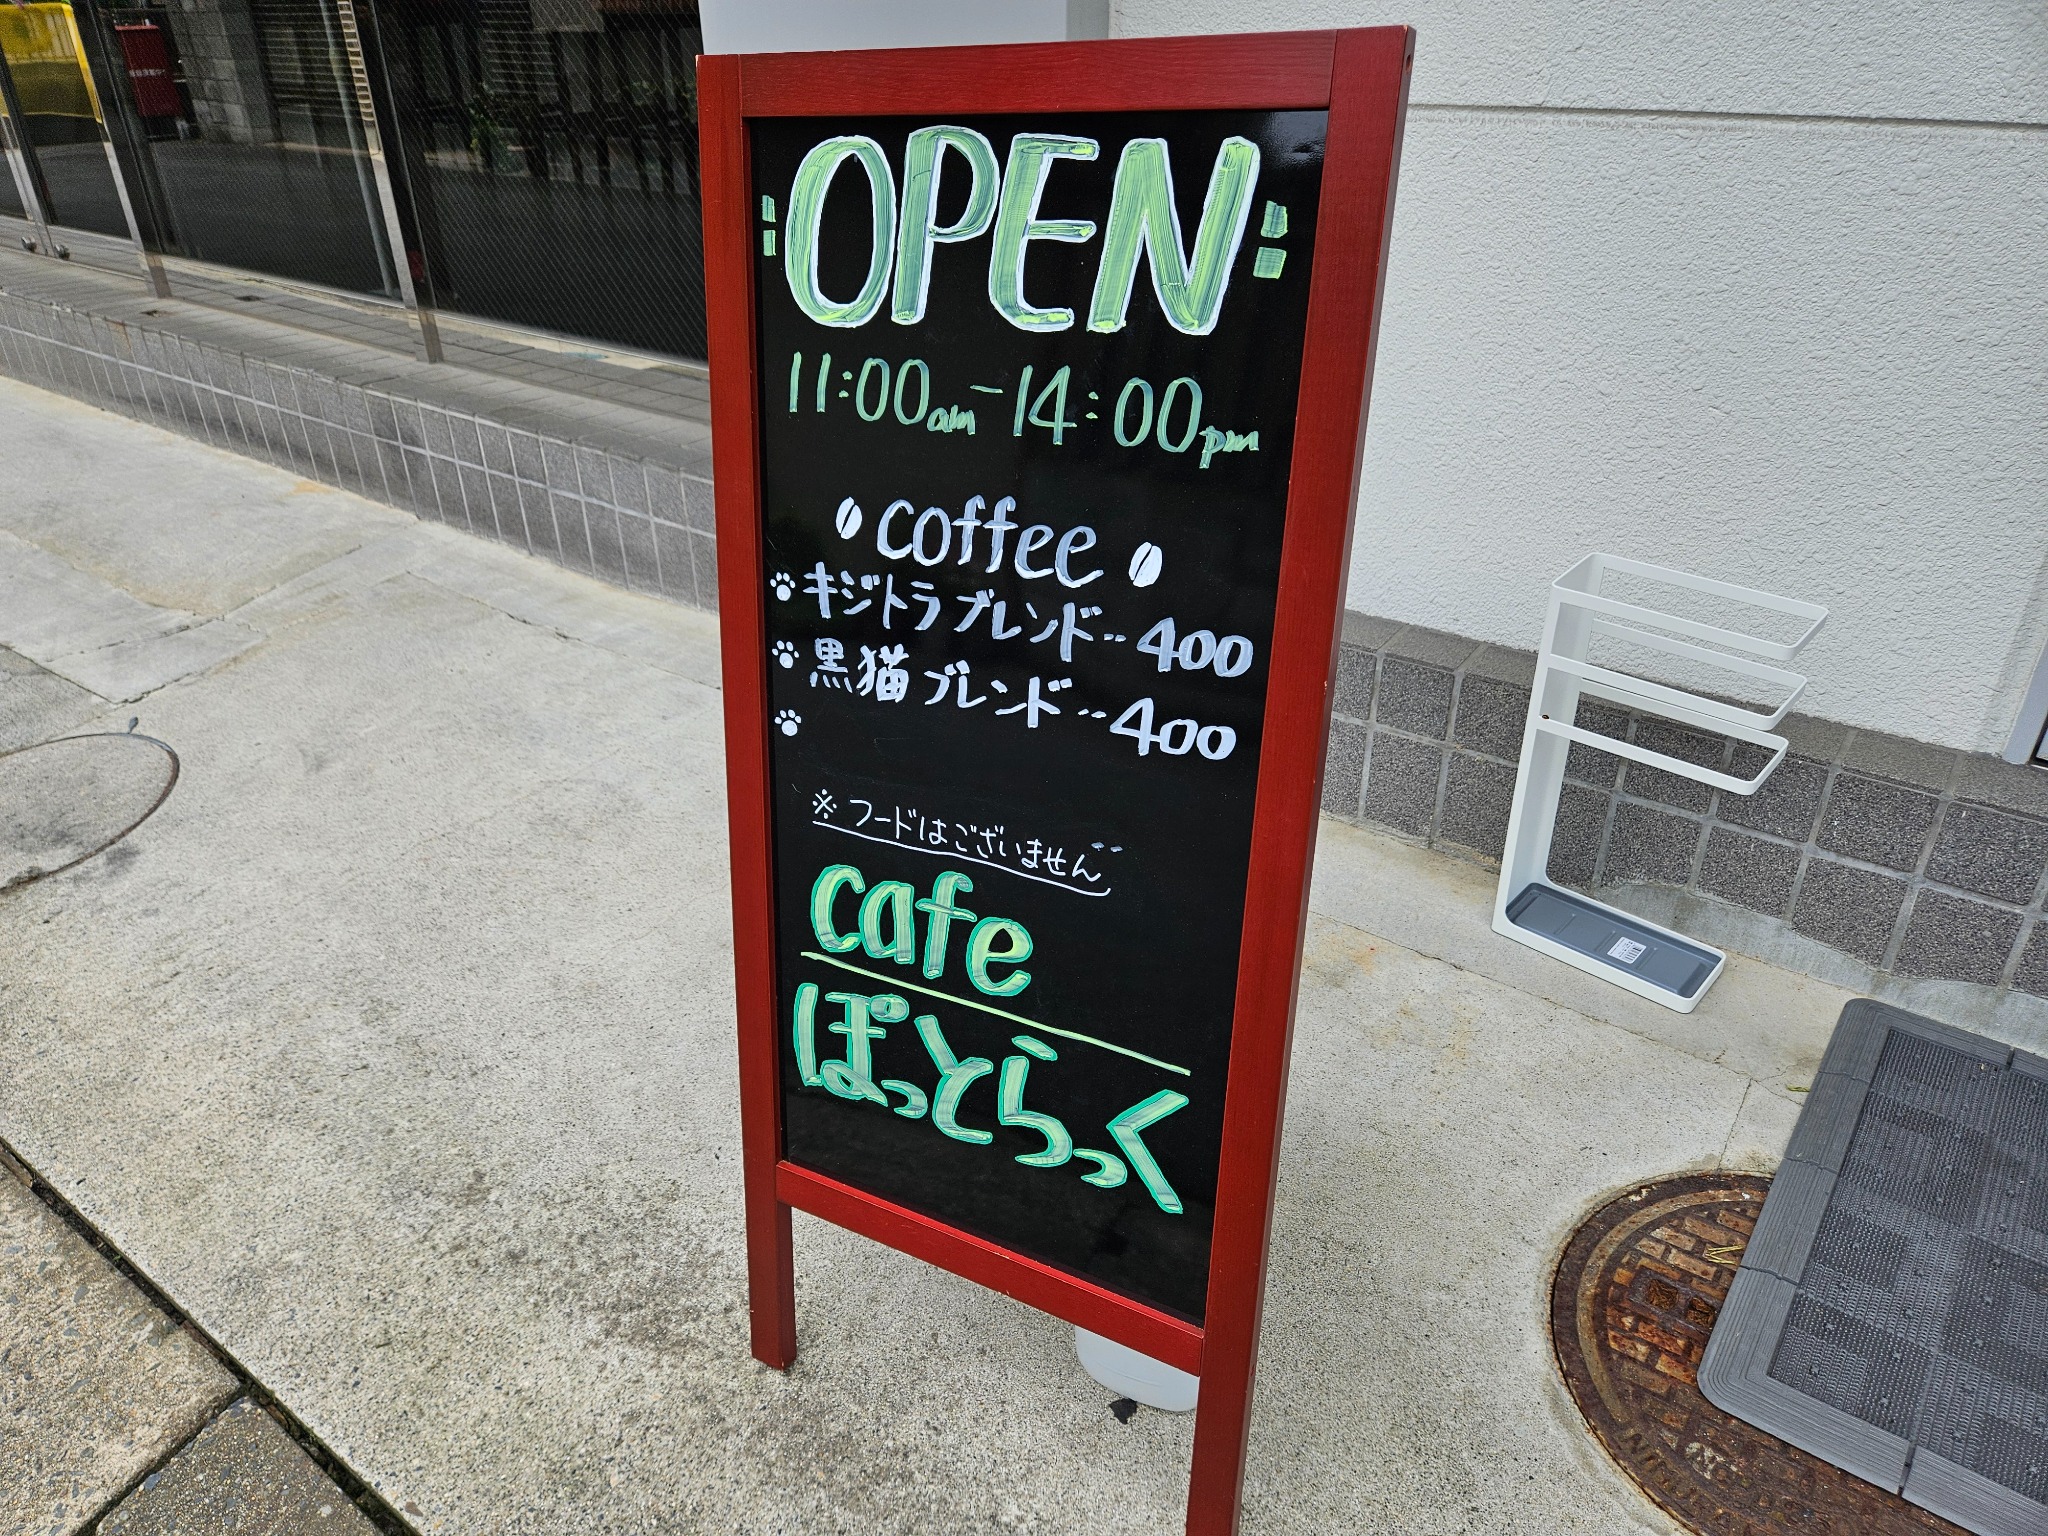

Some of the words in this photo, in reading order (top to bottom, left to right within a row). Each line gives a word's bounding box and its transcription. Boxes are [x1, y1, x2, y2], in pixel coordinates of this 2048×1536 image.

[785, 125, 1260, 336] OPEN
[876, 495, 1105, 589] coffee
[1136, 616, 1254, 678] 400
[1109, 697, 1237, 761] 400
[810, 863, 1034, 997] cafe
[793, 982, 1190, 1215] ぽっとらっく
